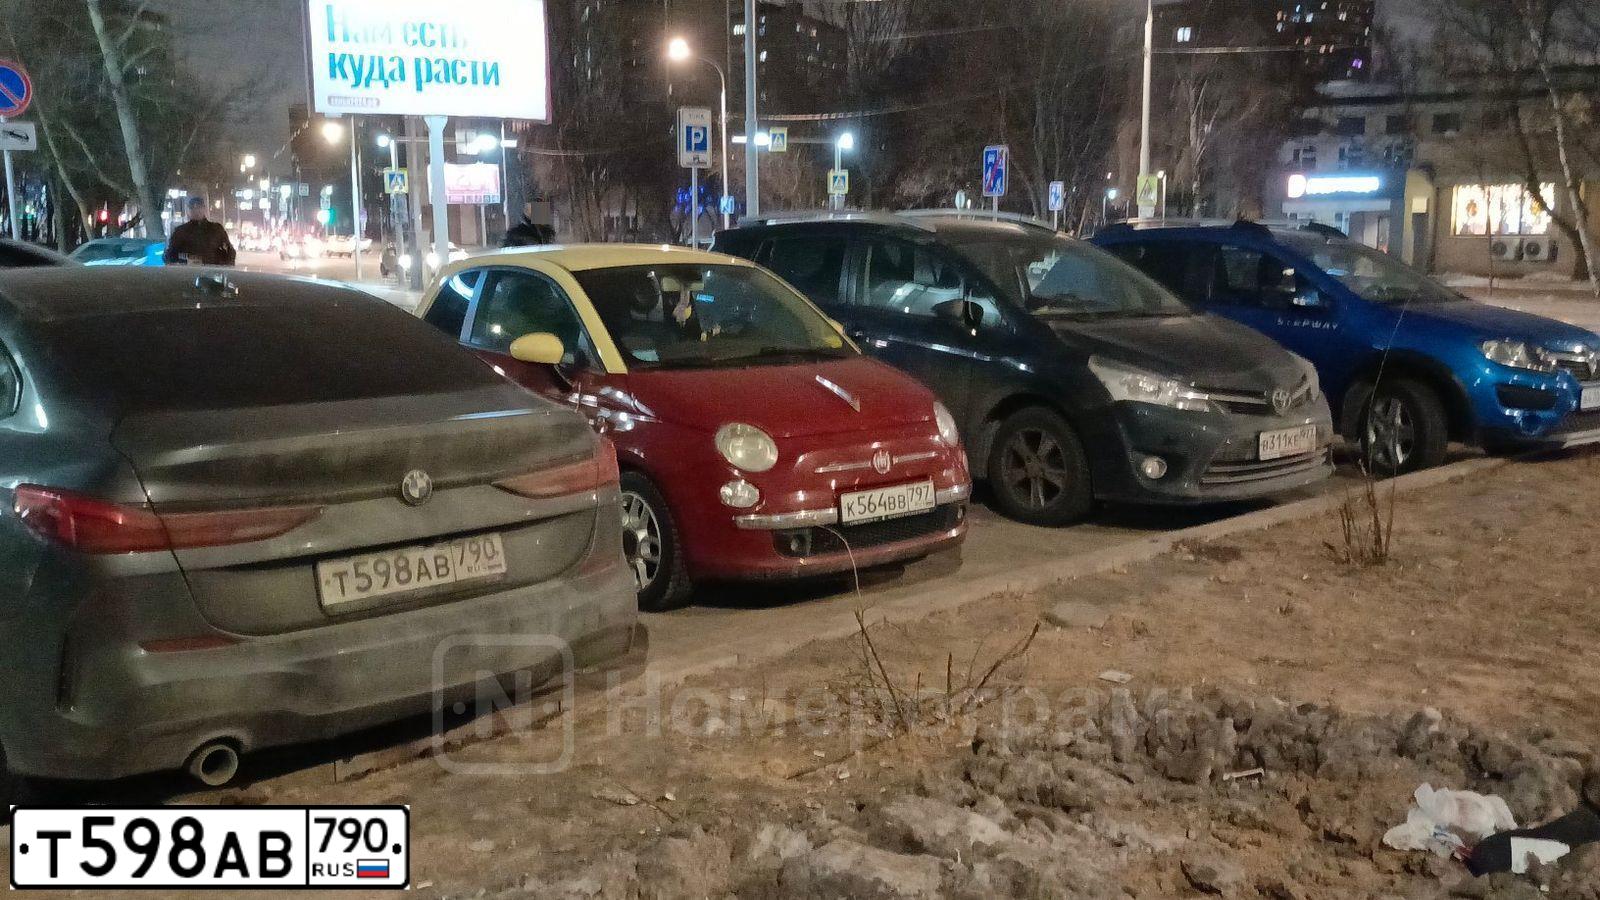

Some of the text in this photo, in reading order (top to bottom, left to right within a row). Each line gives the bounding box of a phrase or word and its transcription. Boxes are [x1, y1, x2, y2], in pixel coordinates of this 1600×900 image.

[328, 52, 500, 92] куда расти
[907, 485, 930, 502] 797
[332, 538, 496, 597] Т598АВ 790
